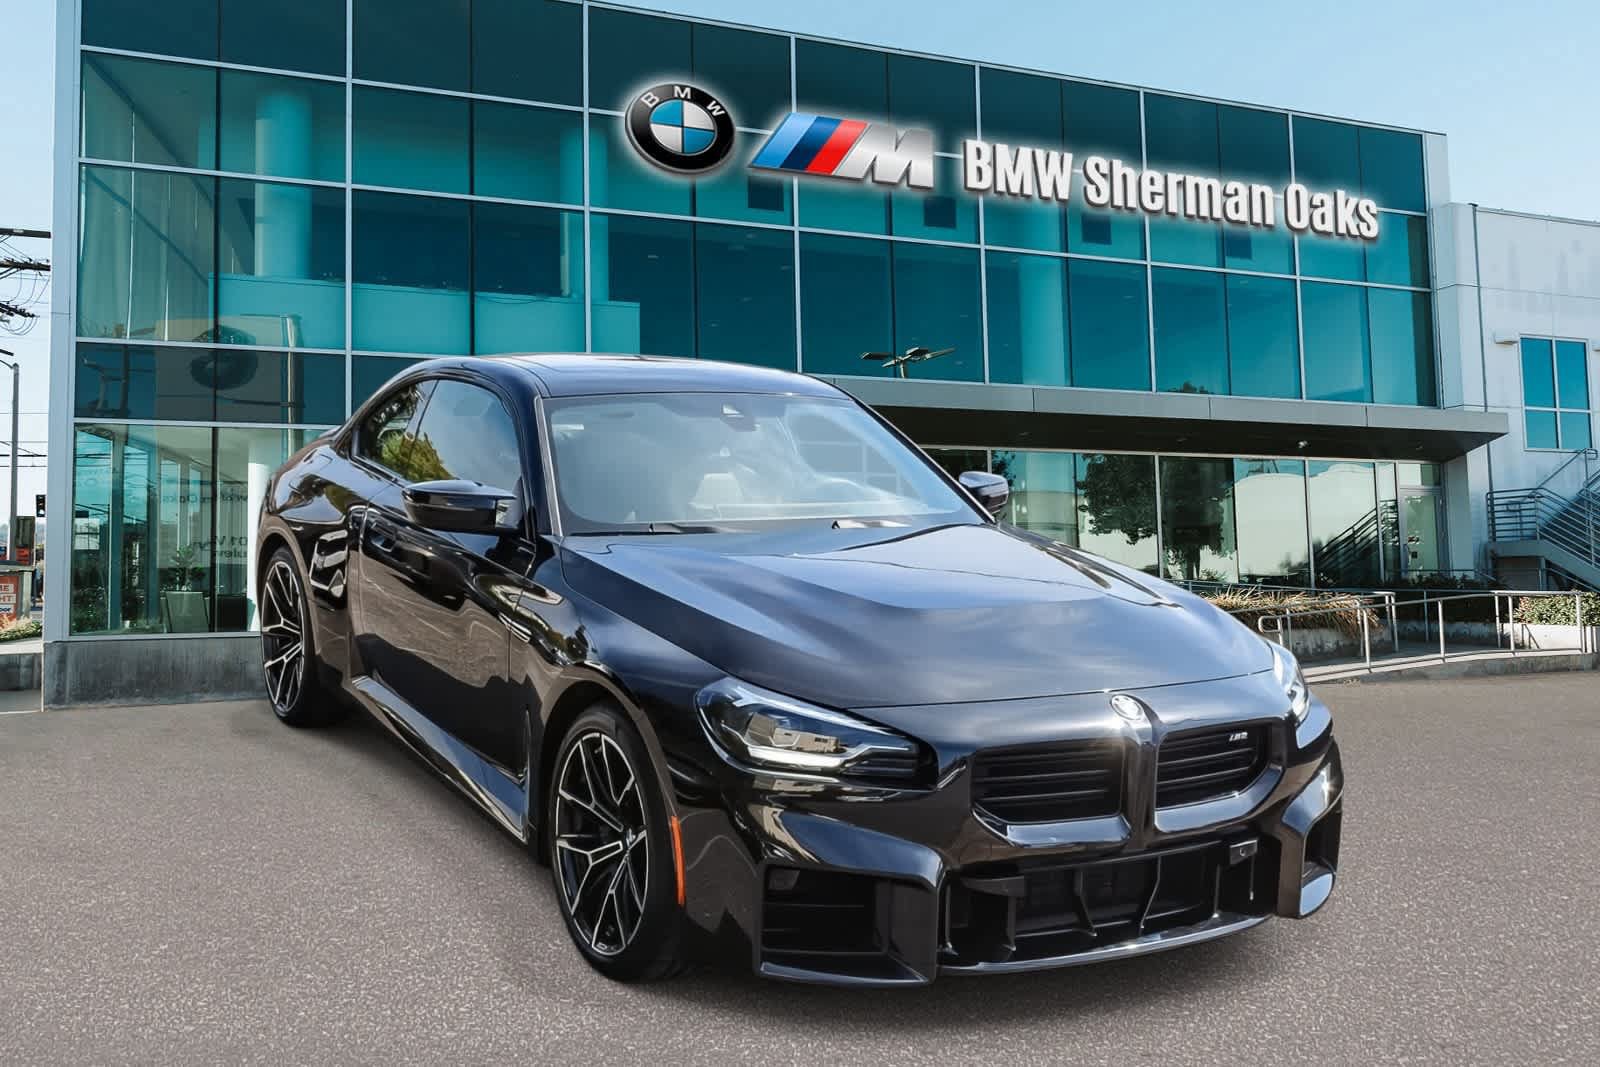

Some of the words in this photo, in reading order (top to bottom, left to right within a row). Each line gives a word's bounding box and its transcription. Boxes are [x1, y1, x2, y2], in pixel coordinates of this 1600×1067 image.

[640, 85, 726, 117] BMW
[964, 138, 1073, 201] BMW
[1083, 155, 1275, 228] Sherman
[1284, 182, 1380, 241] Oaks
